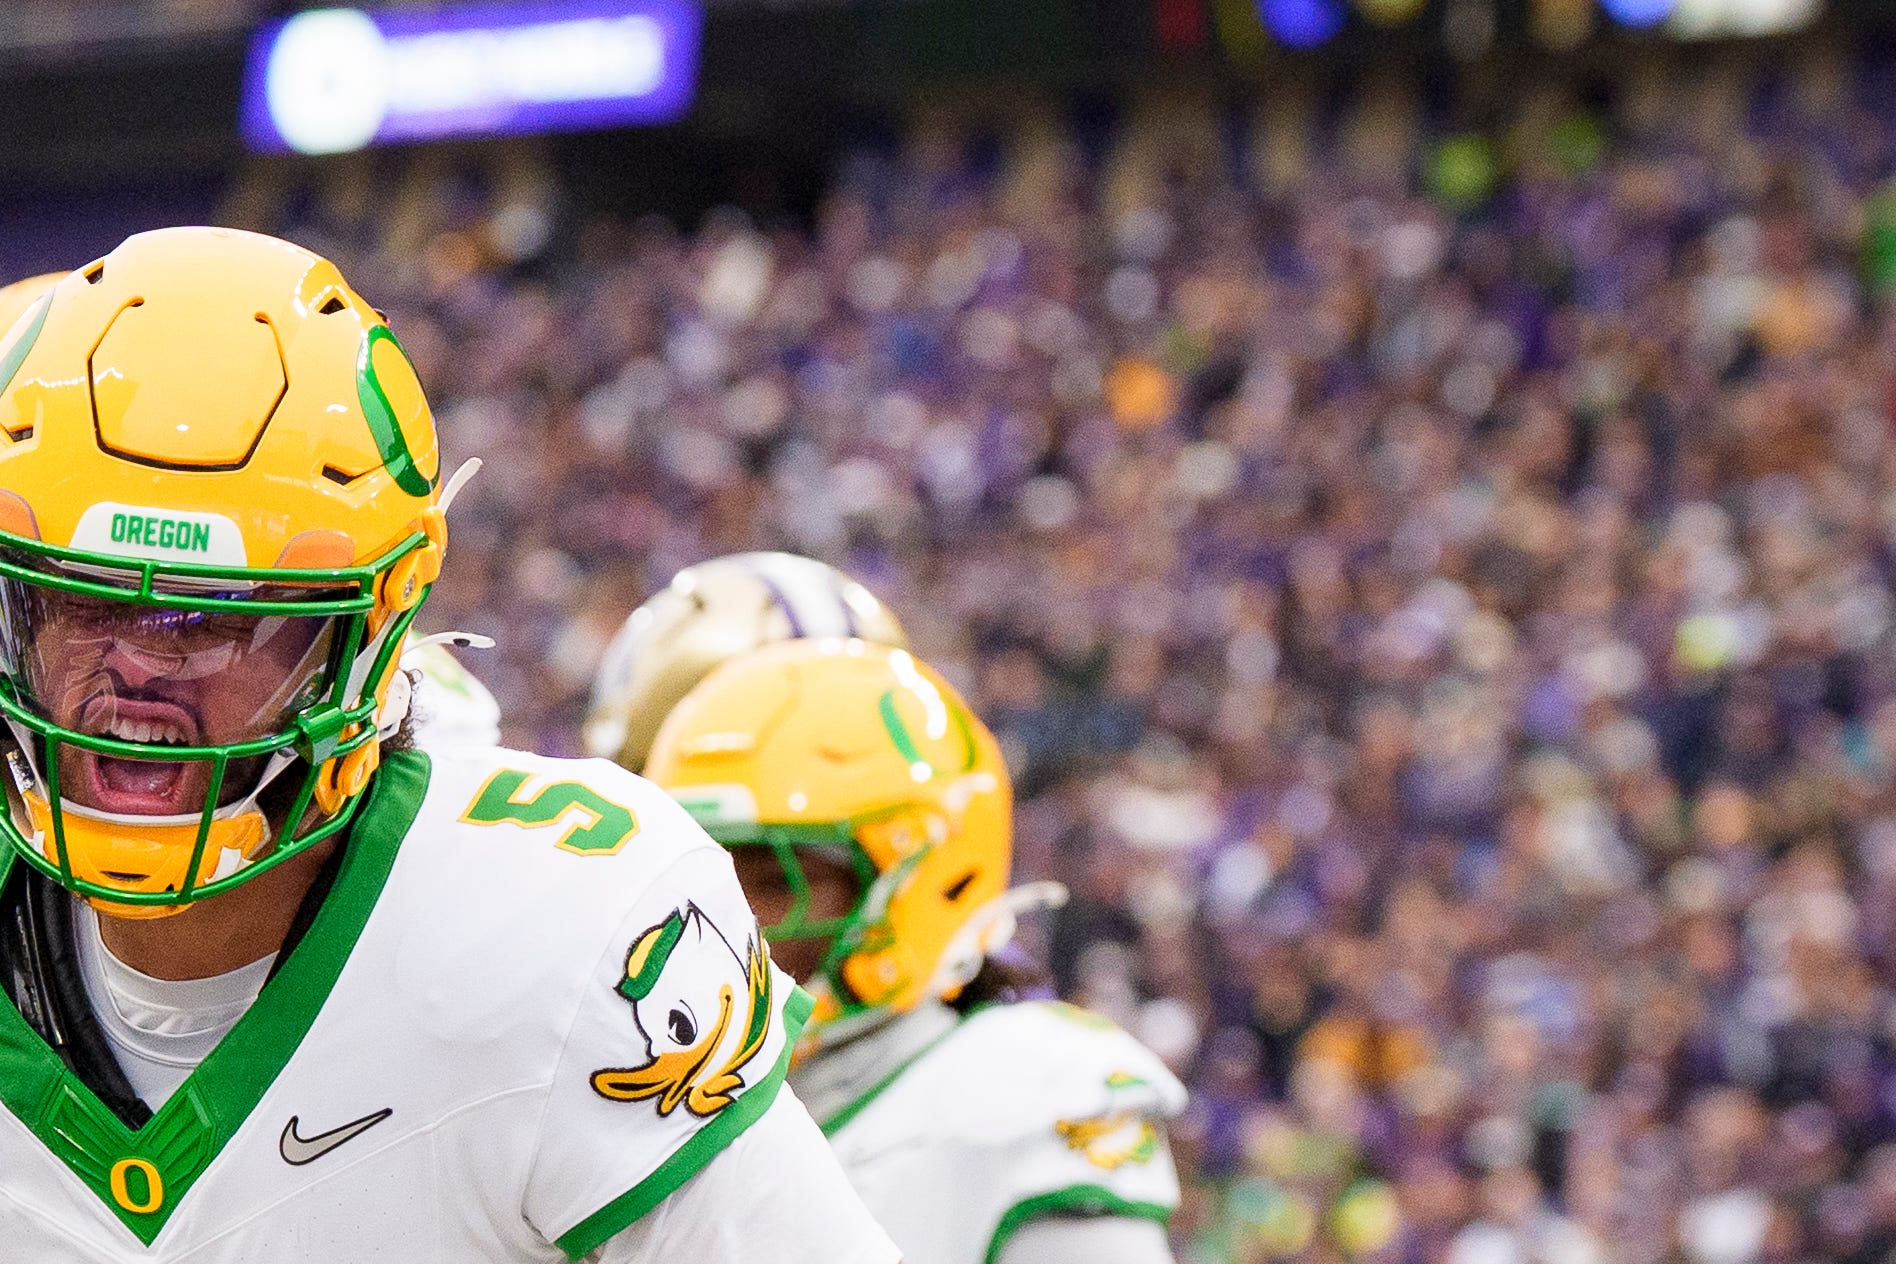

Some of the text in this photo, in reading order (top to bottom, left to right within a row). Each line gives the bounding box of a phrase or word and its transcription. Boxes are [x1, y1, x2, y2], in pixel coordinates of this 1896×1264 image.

[110, 513, 210, 552] OREGON
[456, 767, 641, 857] 5
[110, 1158, 164, 1214] O
